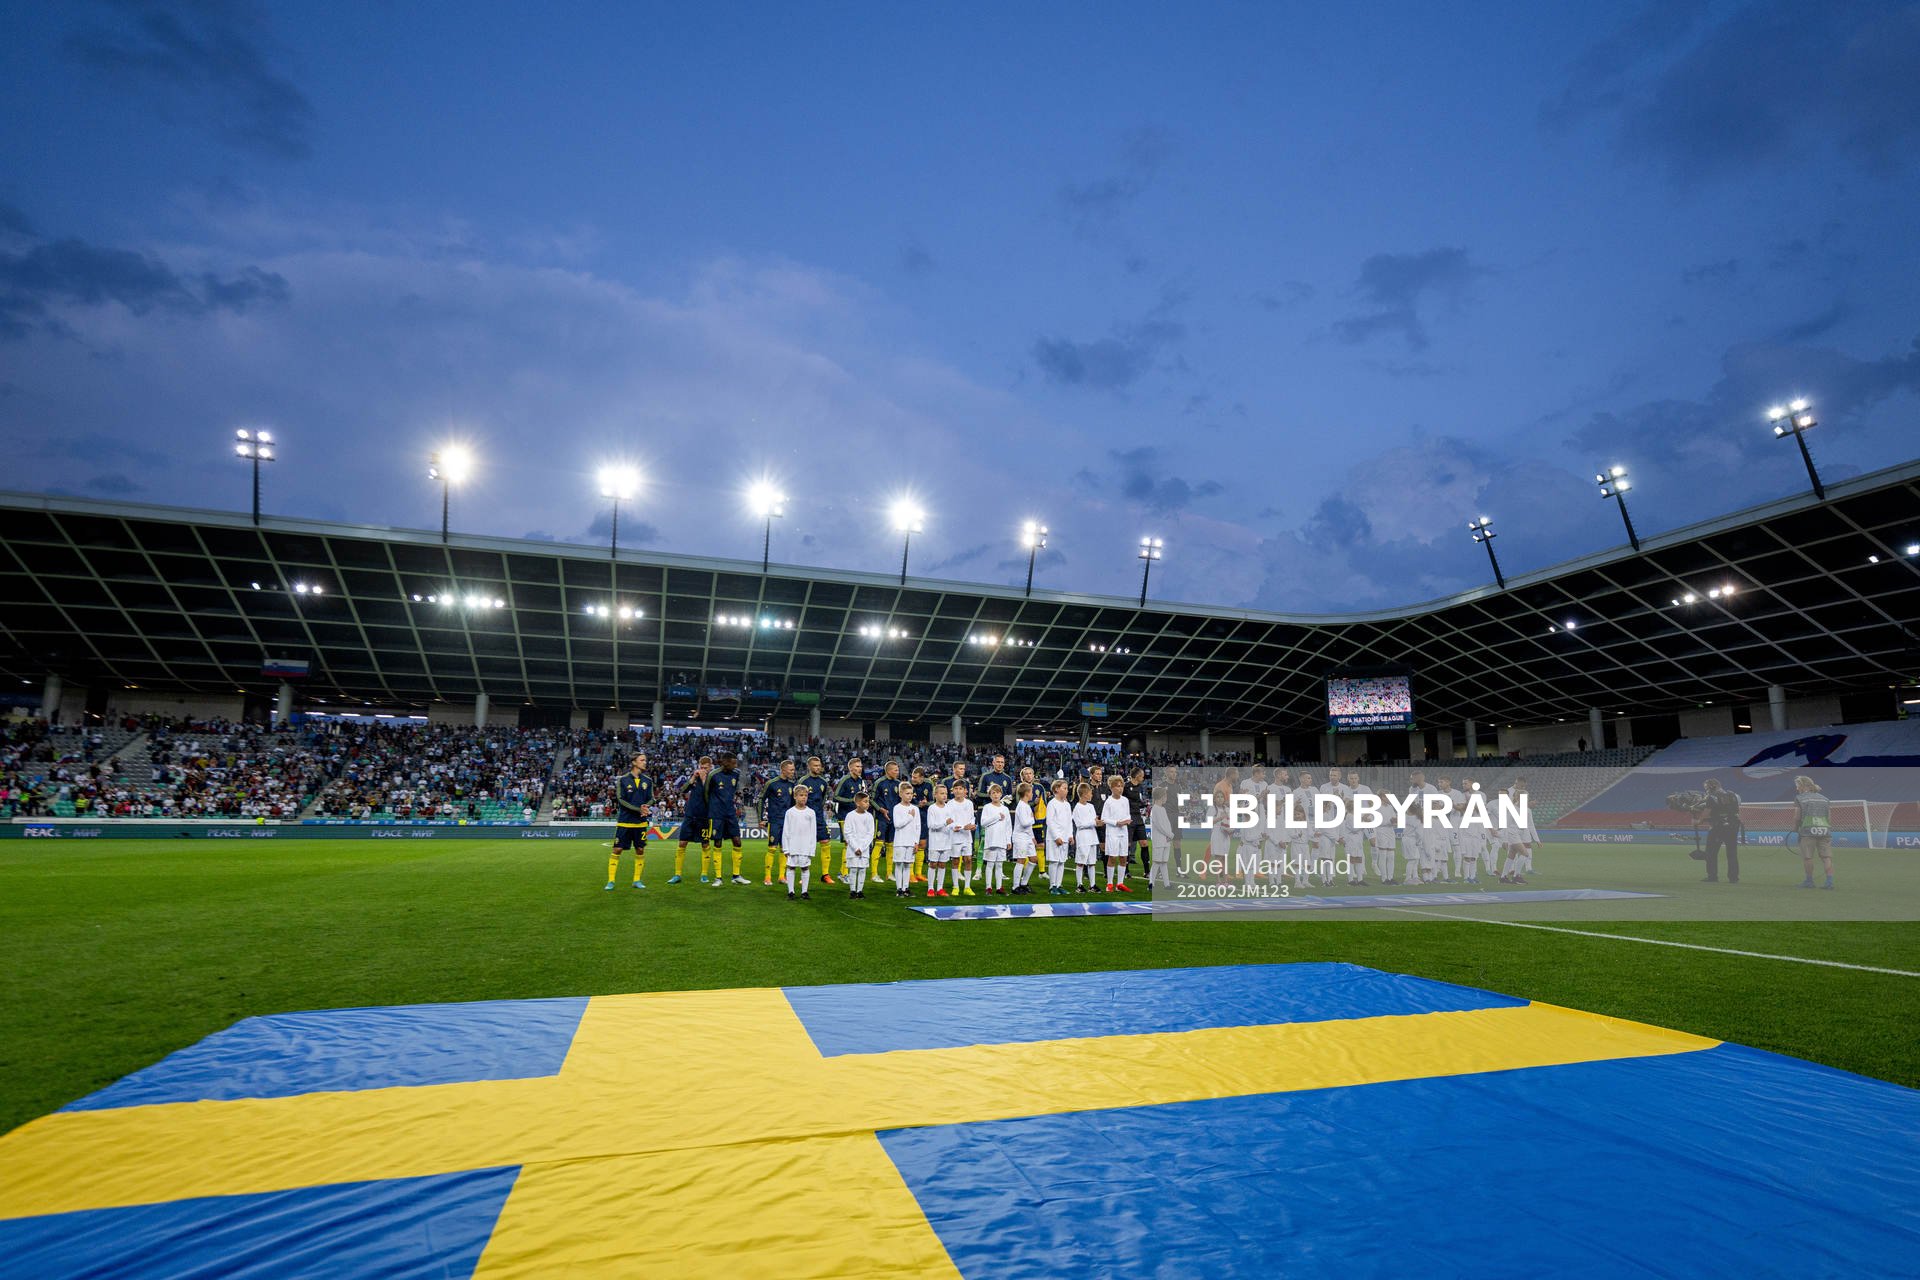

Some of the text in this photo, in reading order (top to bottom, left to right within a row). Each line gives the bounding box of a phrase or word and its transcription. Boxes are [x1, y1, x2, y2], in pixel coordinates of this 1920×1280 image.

[1810, 826, 1828, 835] 037
[1583, 834, 1607, 842] PEACE
[1758, 835, 1784, 844] МИР
[1896, 836, 1920, 846] PEA
